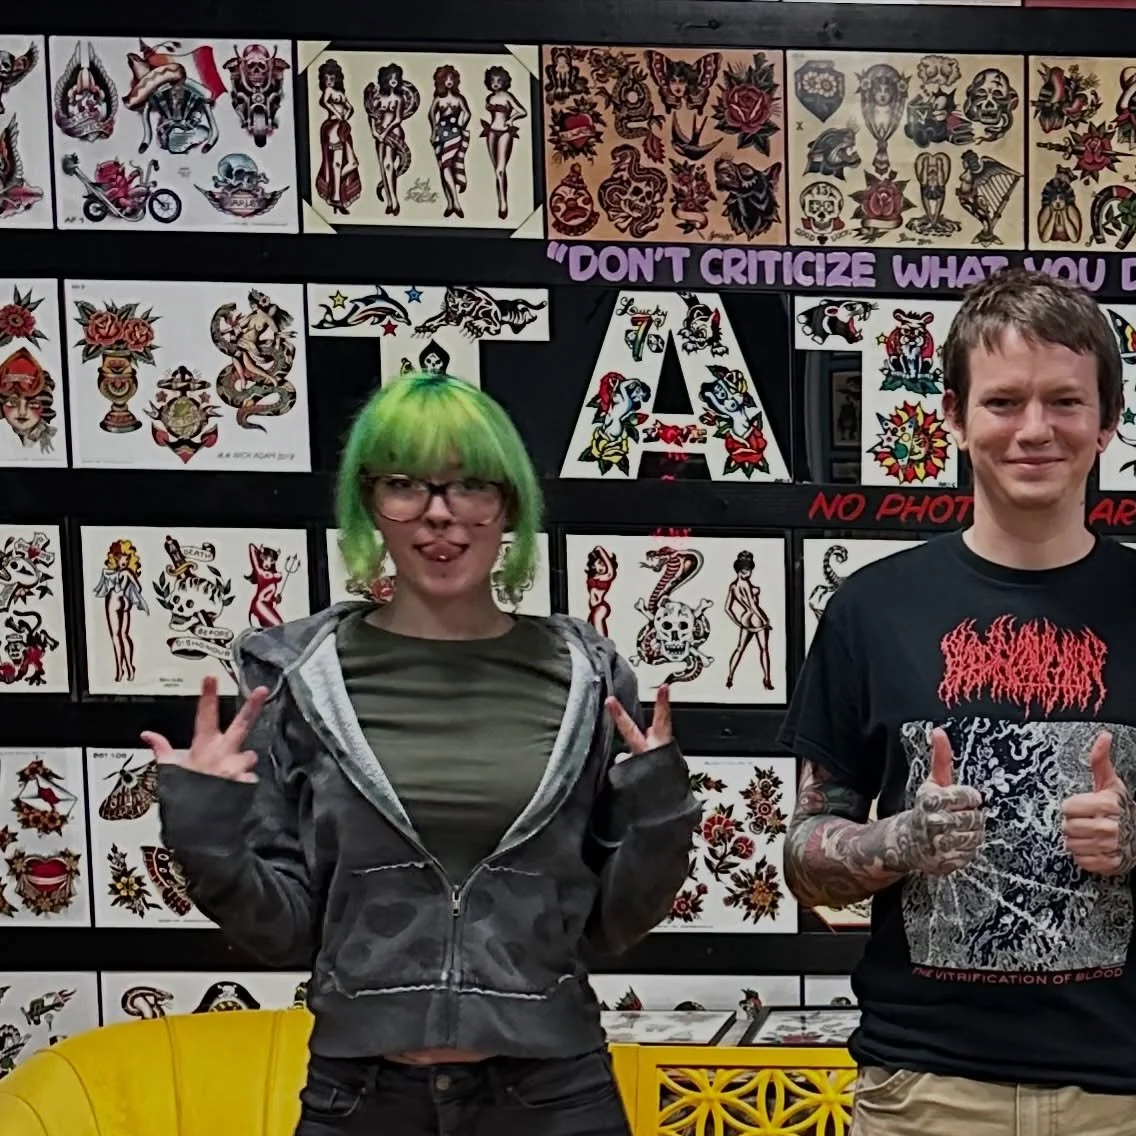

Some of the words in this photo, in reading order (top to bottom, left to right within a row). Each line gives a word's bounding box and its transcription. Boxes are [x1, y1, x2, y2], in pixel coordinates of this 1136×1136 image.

[546, 241, 691, 283] "DON'T
[699, 248, 877, 288] CRITICIZE
[615, 296, 669, 330] Lucky
[808, 491, 866, 521] NO
[875, 493, 975, 524] PHOT
[183, 548, 213, 560] DEATH
[197, 628, 230, 639] BEFORE
[912, 967, 935, 978] THE
[935, 971, 1048, 984] VITRIFICATION
[1052, 974, 1071, 985] OF
[1074, 968, 1124, 982] BLOOD
